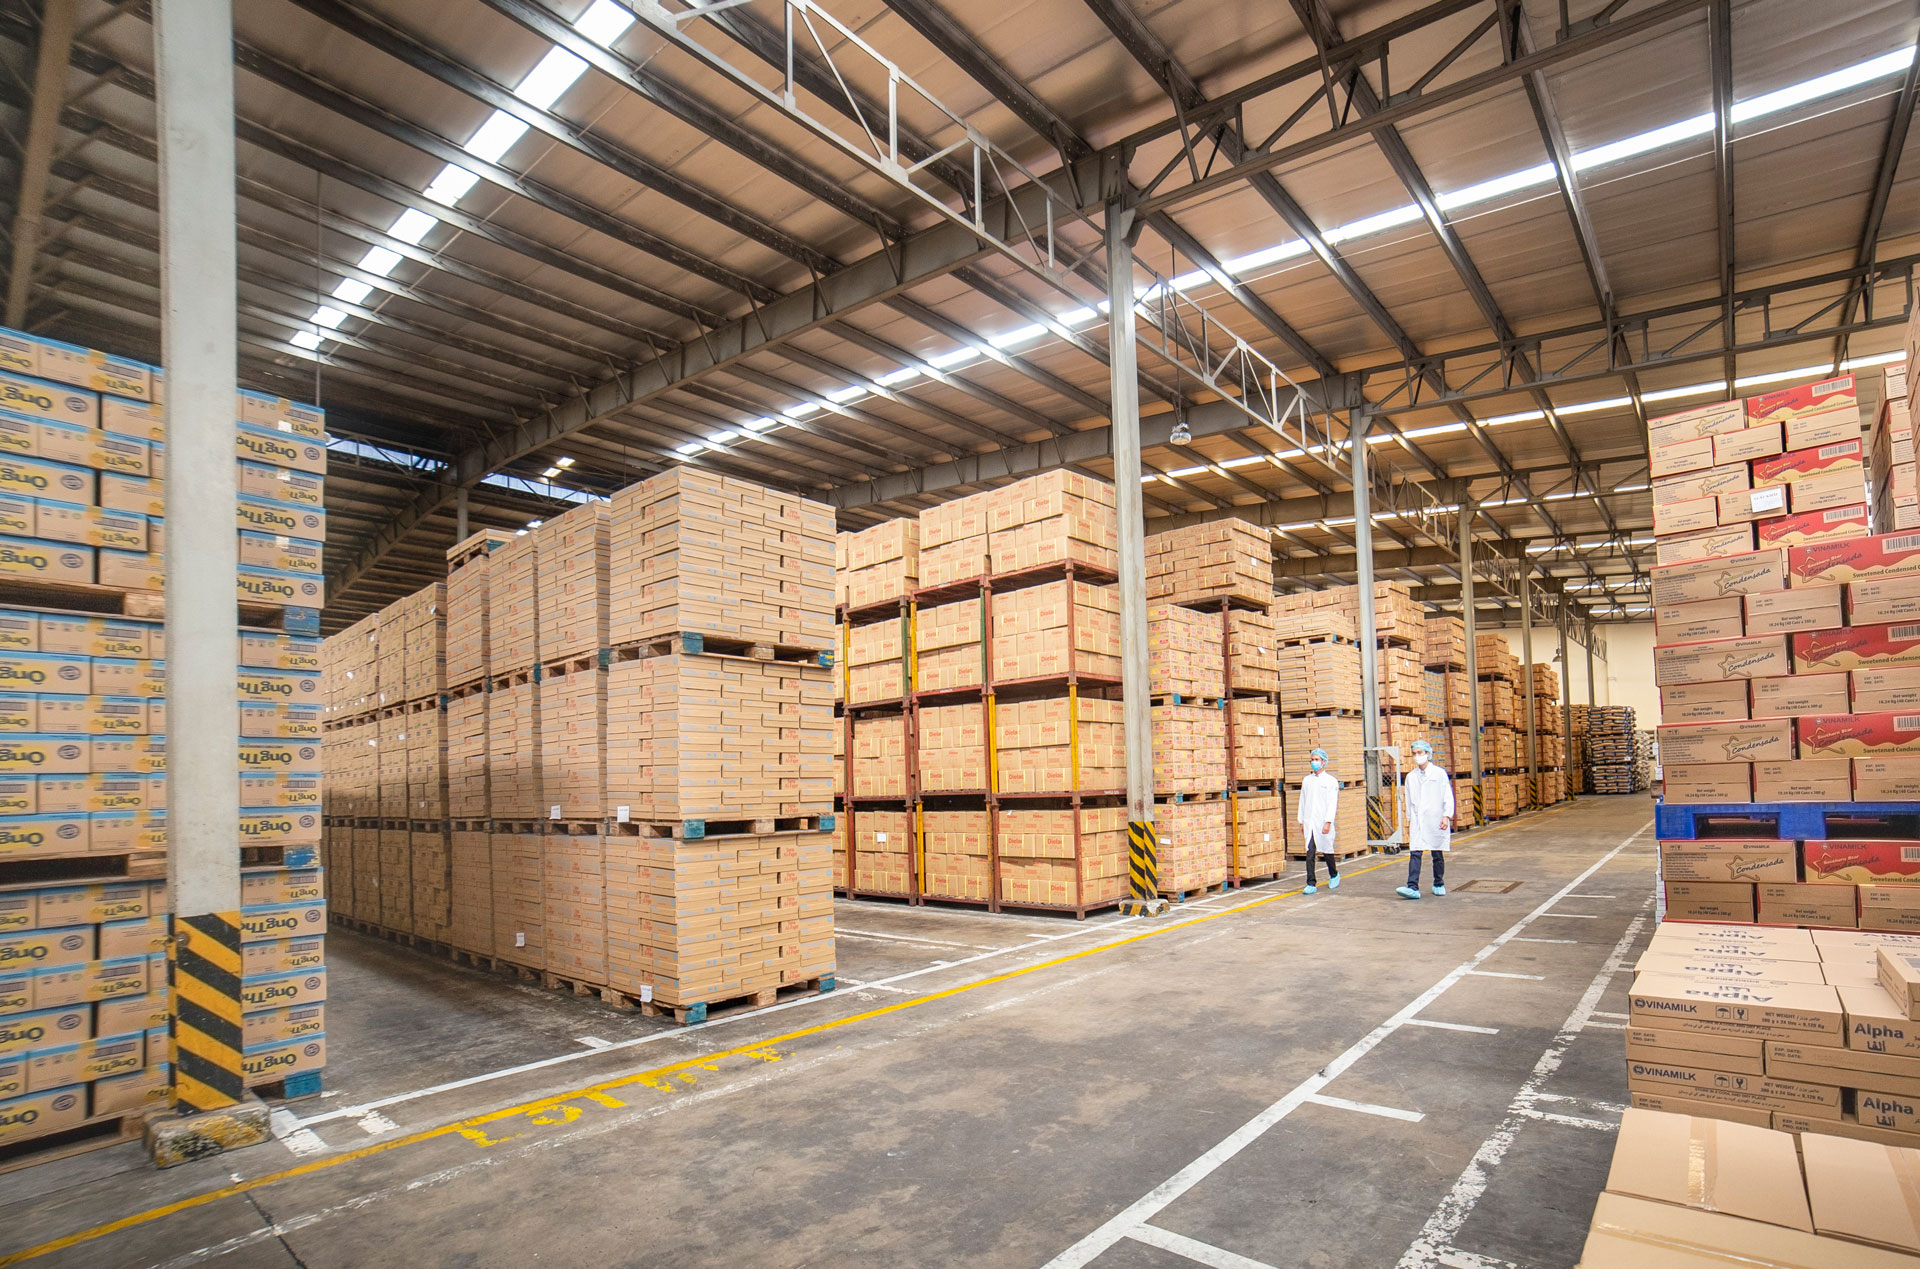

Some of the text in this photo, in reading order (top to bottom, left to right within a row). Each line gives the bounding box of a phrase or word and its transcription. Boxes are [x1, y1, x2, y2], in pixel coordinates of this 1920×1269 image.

[1723, 567, 1771, 590] Condensada
[1852, 565, 1917, 578] Sweetened Condensed
[1727, 652, 1775, 672] Condensada
[1858, 657, 1889, 666] Sweetened
[1731, 736, 1779, 754] Condensada
[1863, 746, 1895, 754] Sweetened
[1735, 857, 1784, 874] Condensada
[1685, 989, 1773, 1003] Alpha
[1645, 1000, 1697, 1013] VINAMILK
[1854, 1022, 1904, 1039] Alpha
[1644, 1067, 1697, 1081] VINAMILK
[1863, 1096, 1914, 1116] Alpha
